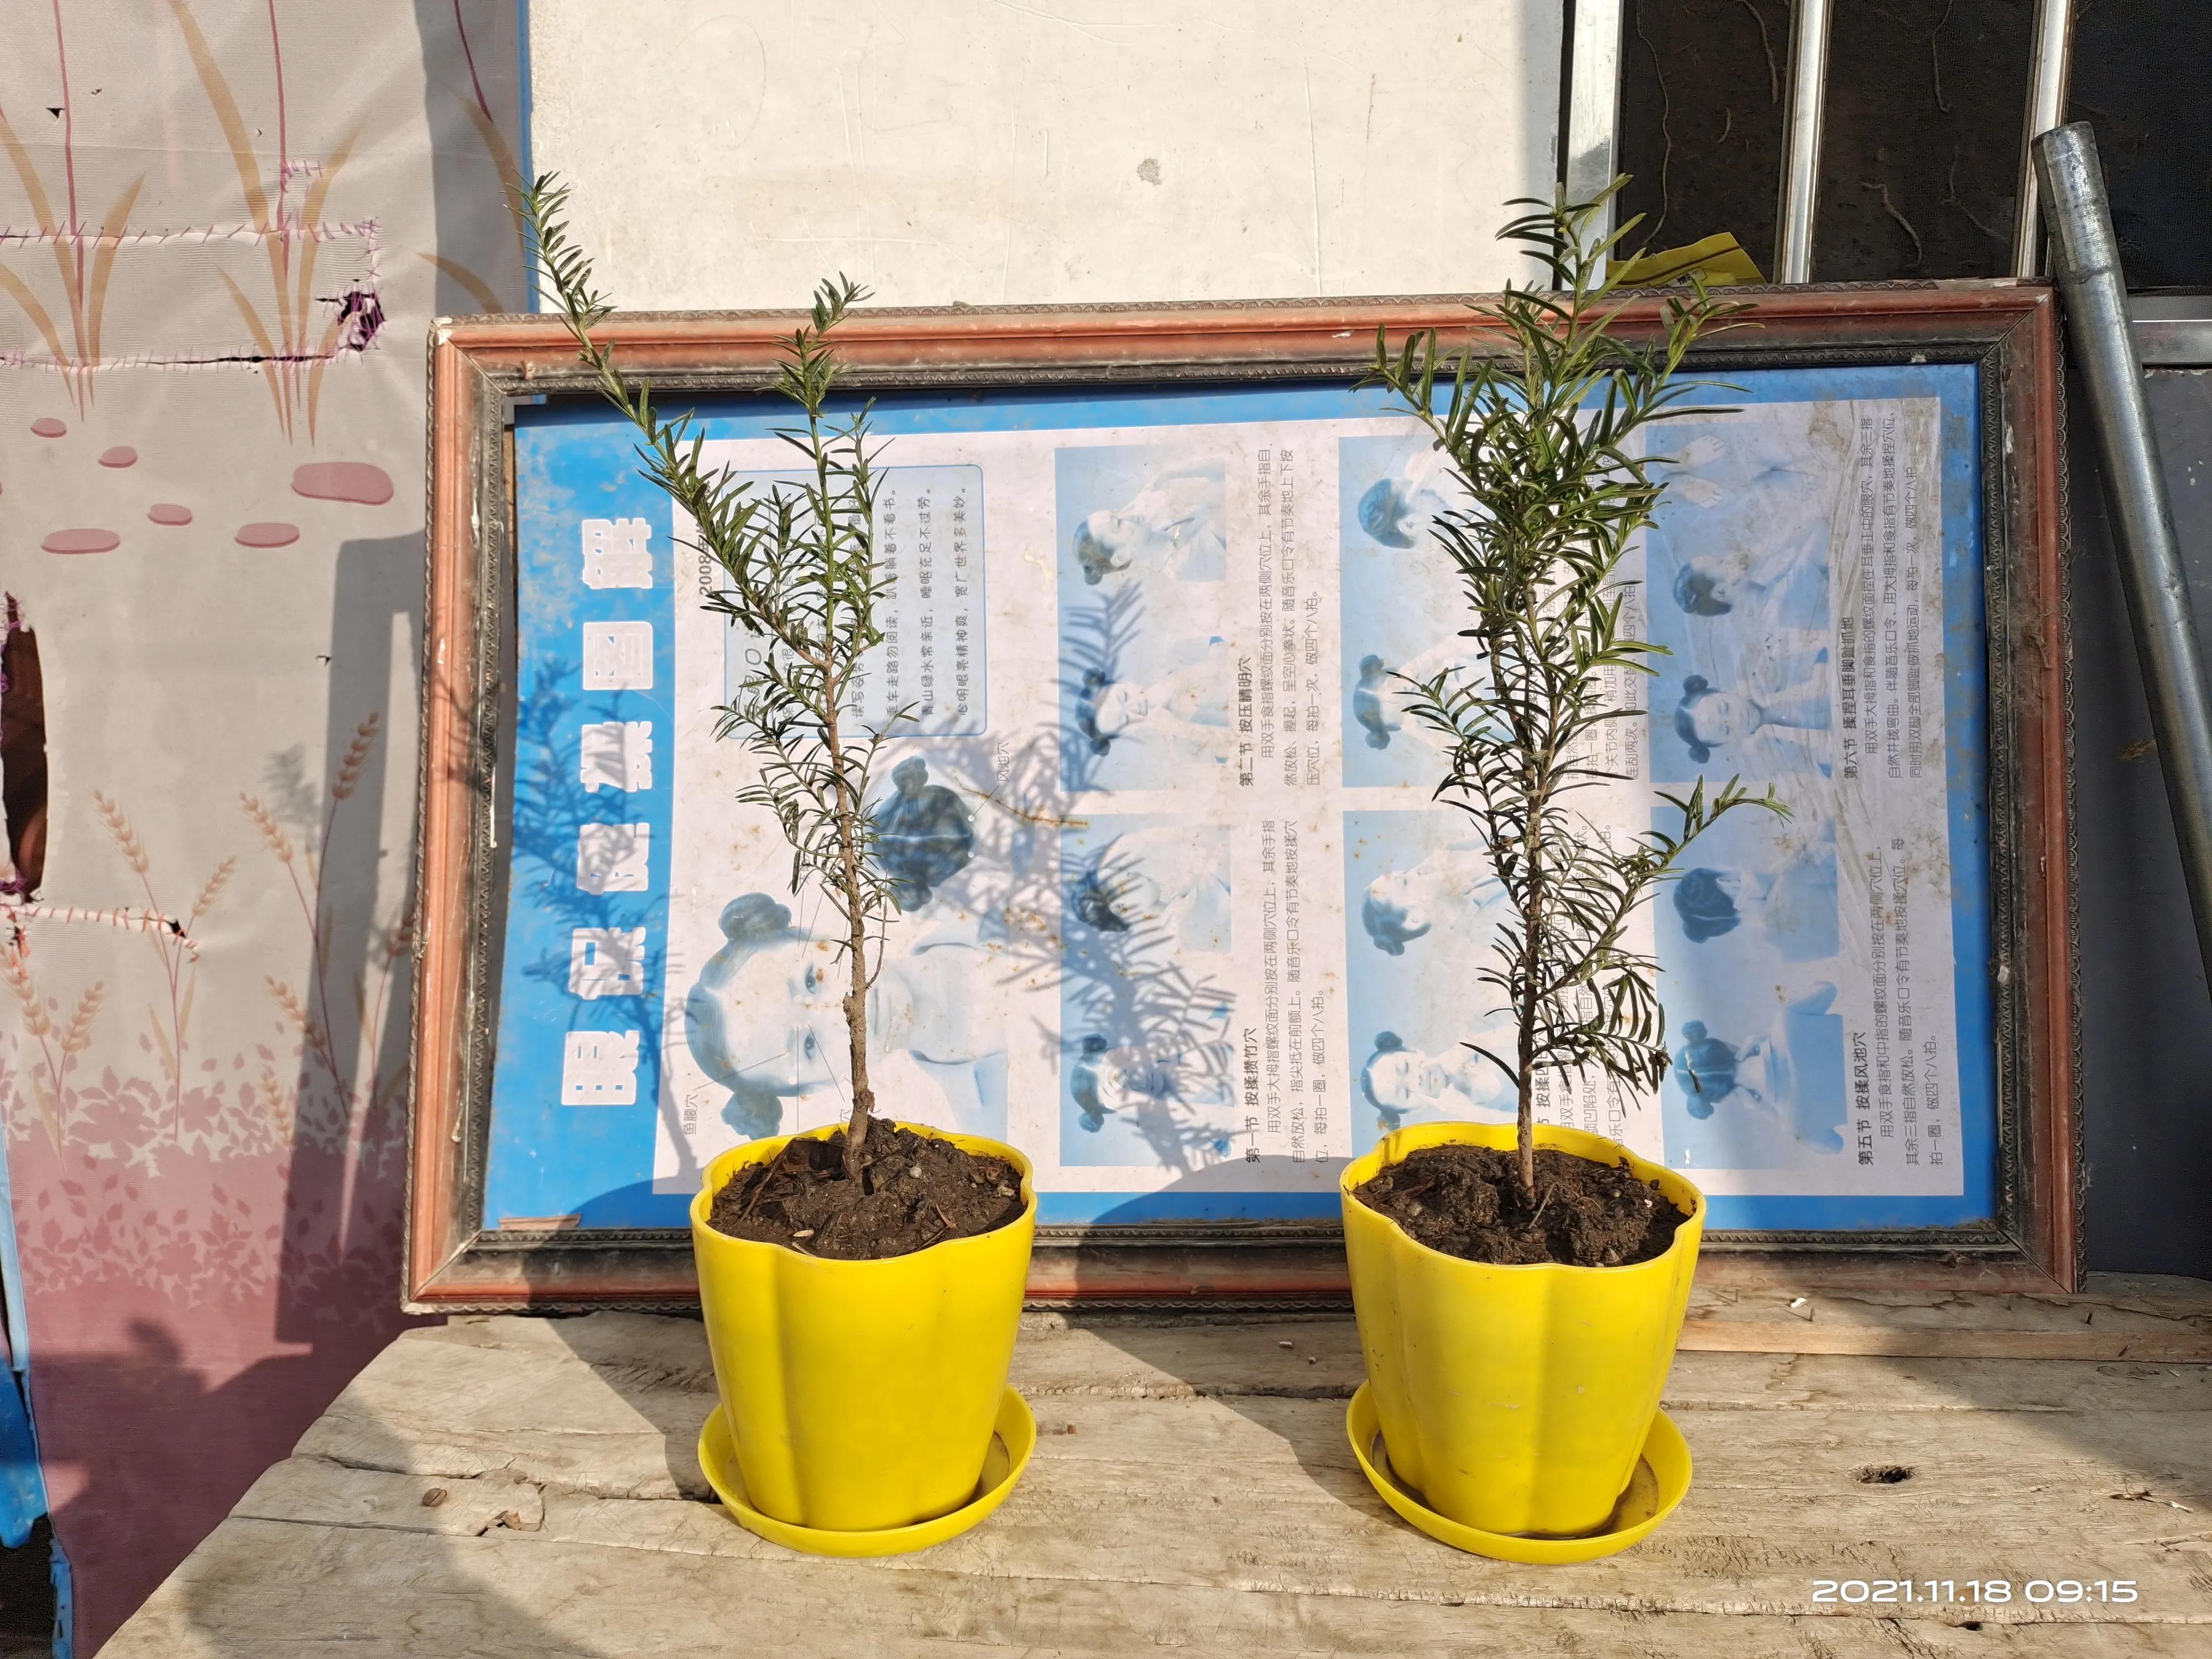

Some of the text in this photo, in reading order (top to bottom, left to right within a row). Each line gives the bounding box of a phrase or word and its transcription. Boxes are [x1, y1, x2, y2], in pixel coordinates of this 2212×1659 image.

[917, 488, 934, 716] 青山绿水常亲近，睡眠充足不过劳。
[953, 487, 969, 716] 心明眼亮精神爽，宽广世界多美妙。
[997, 742, 1010, 781] 风池穴
[1237, 656, 1254, 787] 第二节 按压睛明穴
[1304, 591, 1320, 785] 压穴位，每拍一次，做四个八拍。
[1840, 616, 1858, 779] 第六节 揉捏耳垂脚趾抓地
[561, 517, 653, 1105] 眼保健操图解
[683, 1093, 698, 1135] 鱼腰穴
[1243, 1027, 1261, 1163] 第一节 按揉攒竹穴
[1311, 989, 1328, 1163] 位，每拍一圈，做四个八拍。
[1852, 1031, 1874, 1165] 第五节 按揉风池穴
[1922, 1035, 1943, 1165] 拍一圈，做四个八拍。
